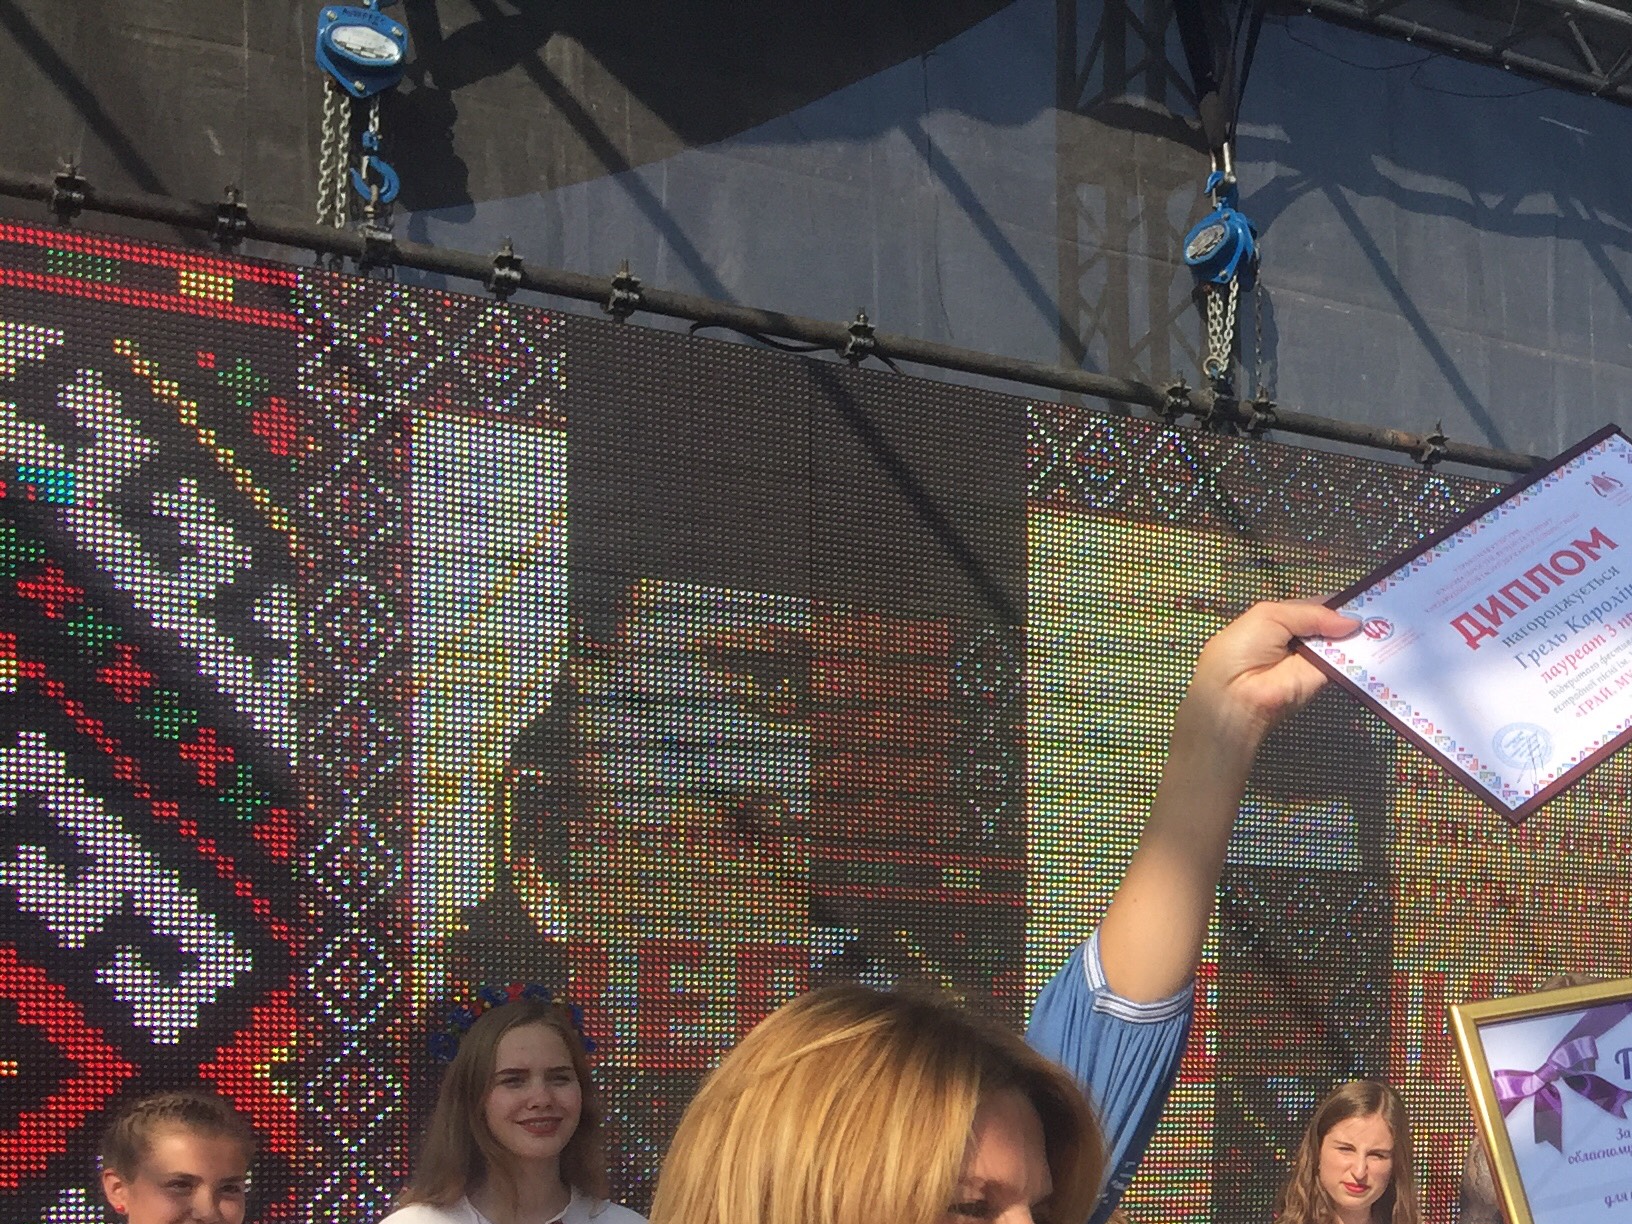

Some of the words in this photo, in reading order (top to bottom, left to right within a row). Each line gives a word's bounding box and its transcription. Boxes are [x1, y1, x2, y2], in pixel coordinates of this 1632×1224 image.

[1449, 526, 1618, 650] ДИПЛОМ
[1501, 565, 1620, 648] нагороджується
[1513, 632, 1567, 669] Грель
[1540, 634, 1606, 683] лауреат
[1603, 623, 1617, 637] 3
[1616, 1127, 1631, 1140] За
[1604, 1191, 1628, 1208] для
